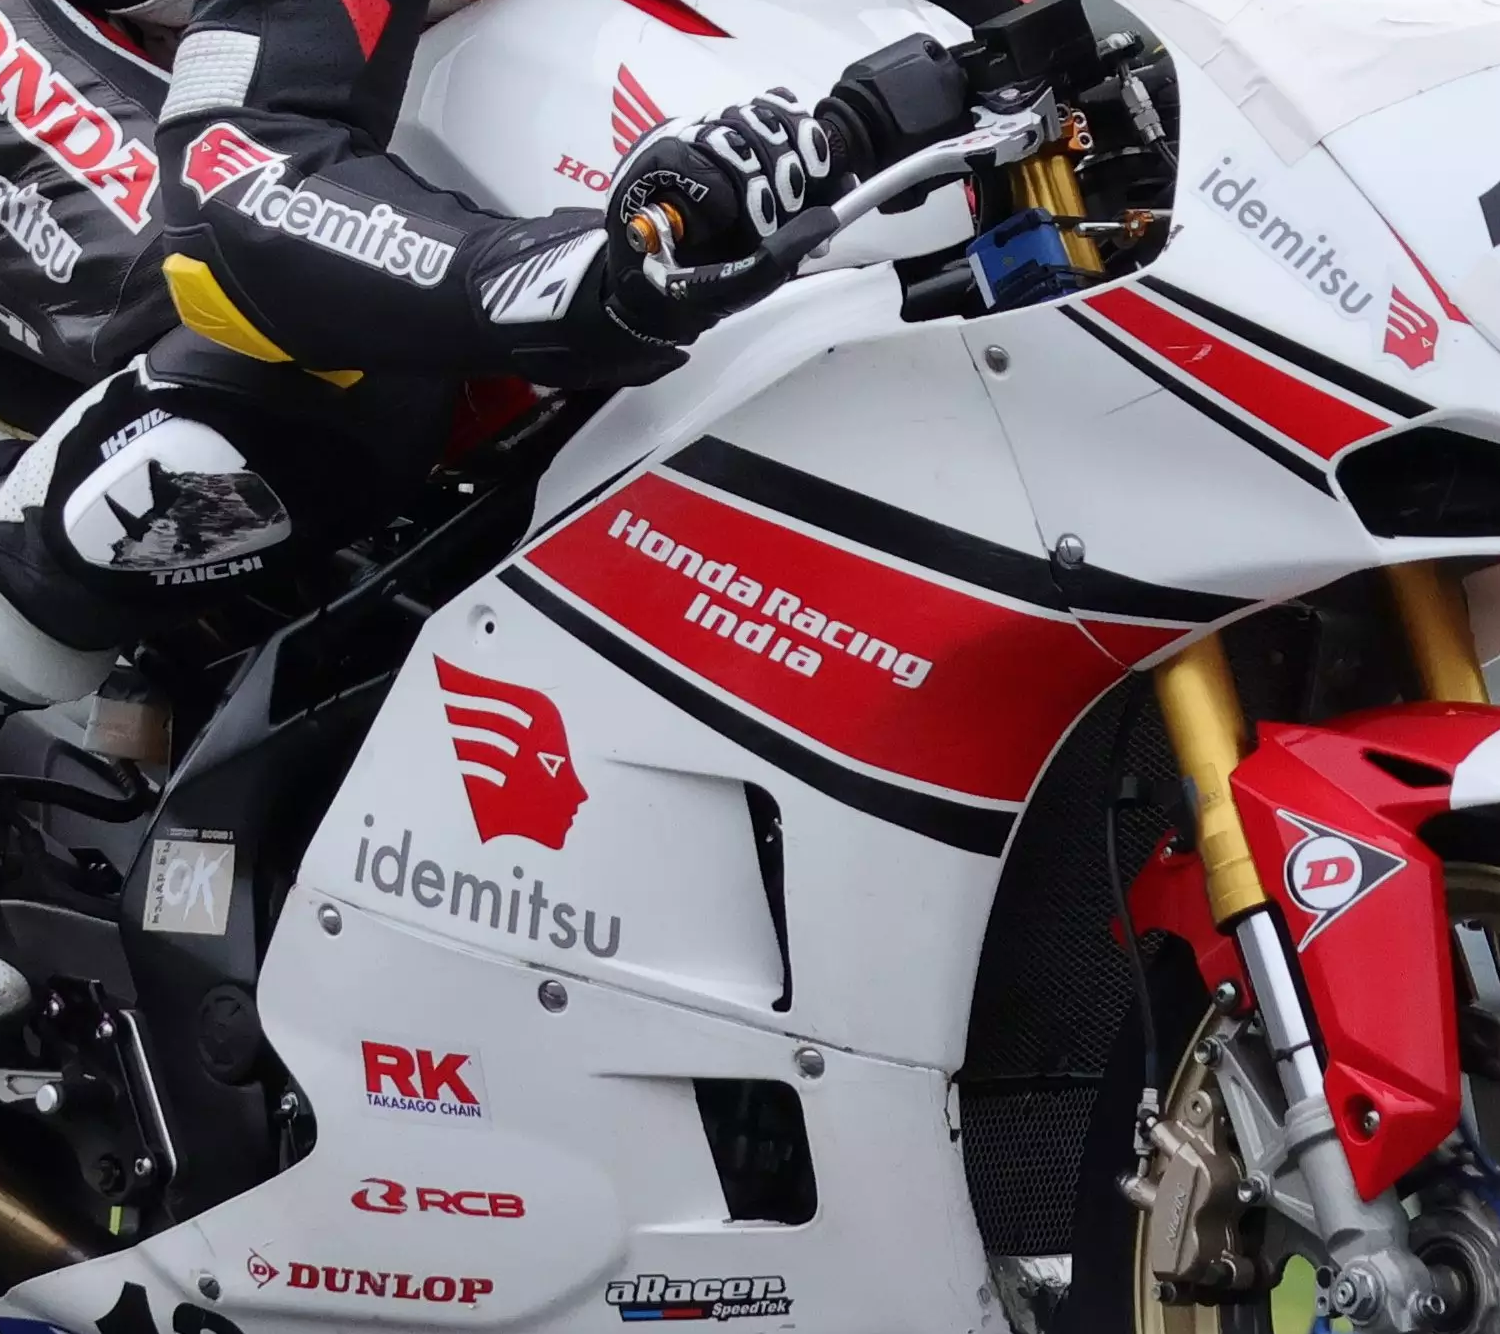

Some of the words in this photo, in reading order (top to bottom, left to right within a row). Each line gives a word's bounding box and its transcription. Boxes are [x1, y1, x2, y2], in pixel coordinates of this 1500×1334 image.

[1198, 155, 1375, 315] idemitsu
[150, 555, 264, 586] TAICHI
[607, 509, 763, 608] Honda
[760, 587, 933, 689] Racing
[683, 592, 822, 678] India
[353, 814, 622, 959] idemitsu
[1301, 856, 1356, 892] D
[361, 1040, 480, 1105] RK
[366, 1093, 437, 1114] TAKASAGO
[440, 1102, 482, 1118] CHAIN
[415, 1186, 527, 1219] RCB
[286, 1261, 494, 1304] DUNLOP
[606, 1274, 787, 1305] aRacer
[711, 1299, 788, 1320] SpeedTek
